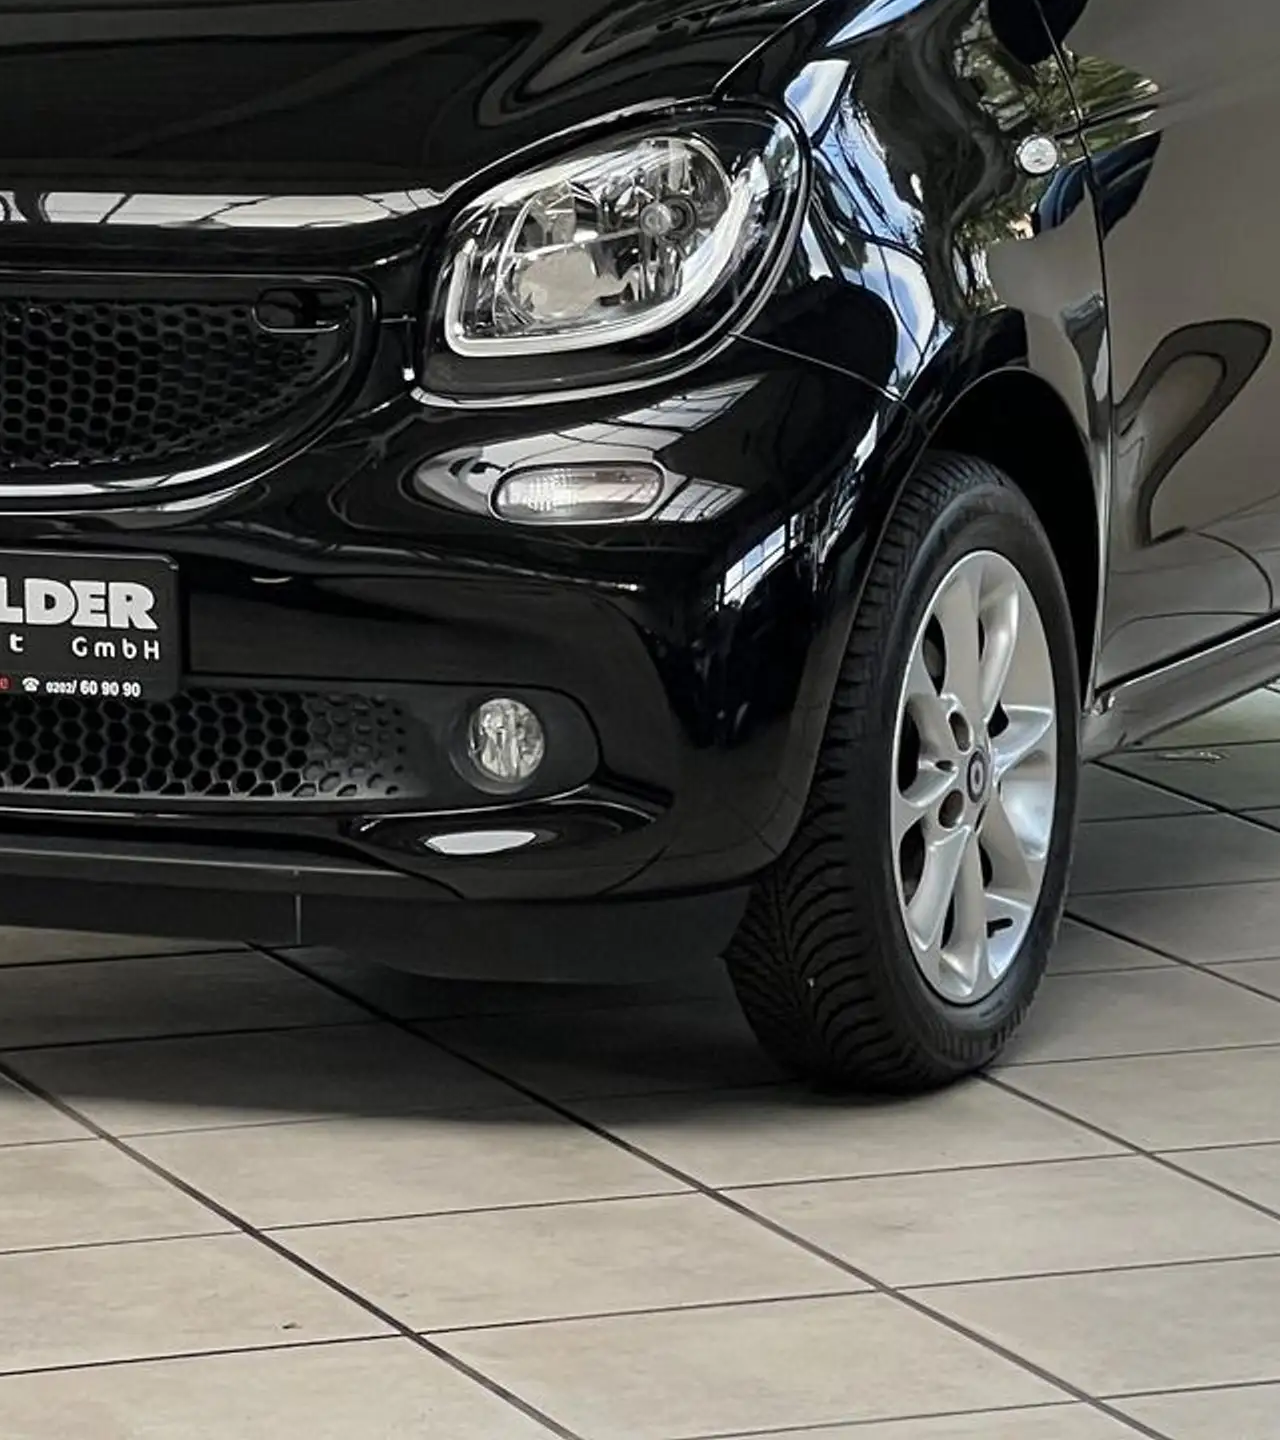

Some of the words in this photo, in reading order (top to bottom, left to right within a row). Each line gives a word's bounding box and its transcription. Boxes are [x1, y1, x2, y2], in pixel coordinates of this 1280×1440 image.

[71, 637, 161, 661] GmbH
[80, 679, 98, 696] 60
[101, 680, 120, 697] 90
[122, 681, 142, 698] 90
